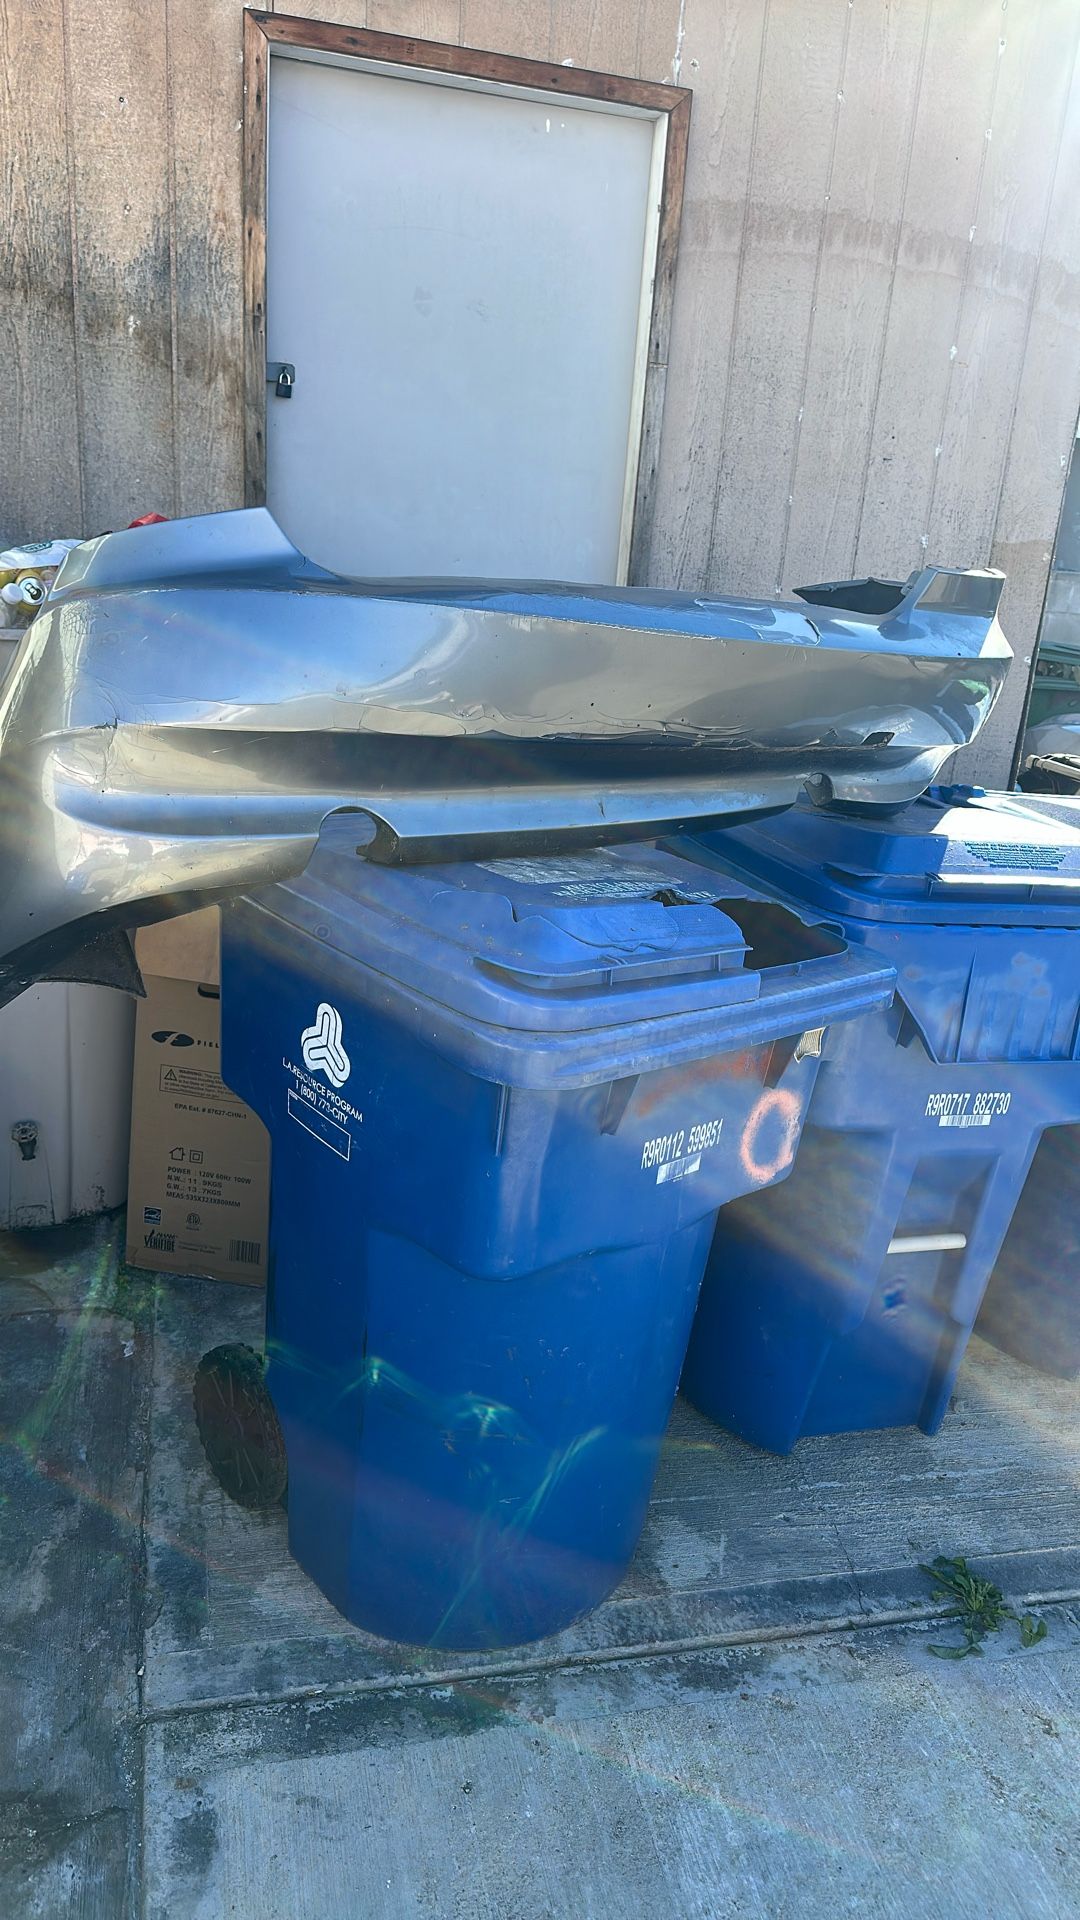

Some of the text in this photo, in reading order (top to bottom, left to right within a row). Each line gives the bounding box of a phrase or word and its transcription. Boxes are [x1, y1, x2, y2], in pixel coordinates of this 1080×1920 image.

[301, 1084, 317, 1105] (800)
[318, 1097, 348, 1124] 773-CITY
[327, 1089, 363, 1123] PROGRAM
[925, 1092, 1011, 1116] R9R0717 882730
[641, 1118, 724, 1170] R9R0112 599851
[168, 1166, 191, 1175] POWER
